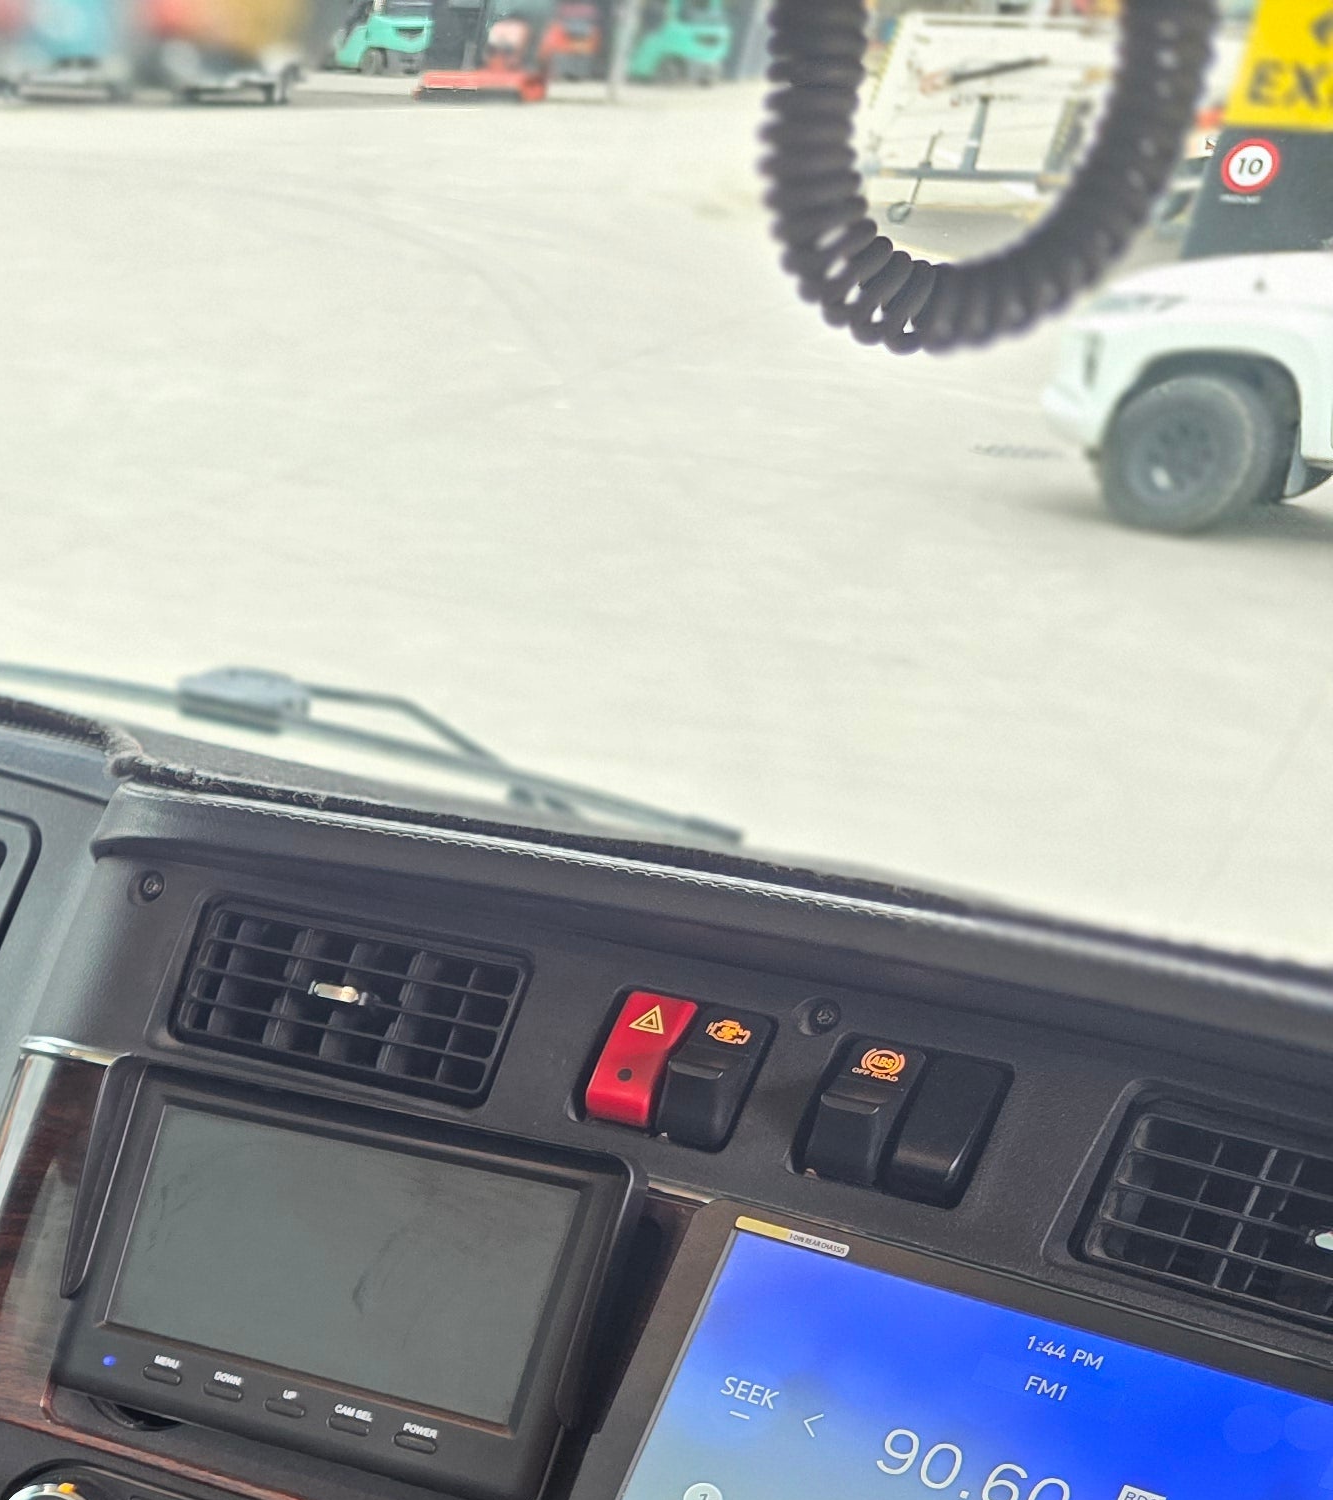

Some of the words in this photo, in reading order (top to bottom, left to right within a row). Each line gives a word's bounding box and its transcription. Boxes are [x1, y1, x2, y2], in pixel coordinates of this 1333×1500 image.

[1247, 58, 1333, 108] EX
[1237, 157, 1264, 175] 10
[870, 1055, 895, 1069] ABS
[851, 1067, 871, 1075] OFF
[871, 1071, 899, 1082] ROAD
[804, 1236, 821, 1247] REAR
[821, 1242, 846, 1254] CHASSIS
[1026, 1334, 1067, 1362] 1:44
[1071, 1348, 1105, 1371] PM
[154, 1354, 181, 1370] MENU
[213, 1371, 243, 1386] DOWN
[282, 1390, 299, 1400] UP
[720, 1376, 780, 1410] SEEK
[1024, 1375, 1068, 1402] FM1
[334, 1403, 354, 1418] CAM
[354, 1409, 373, 1423] SEL
[403, 1421, 438, 1439] POWER
